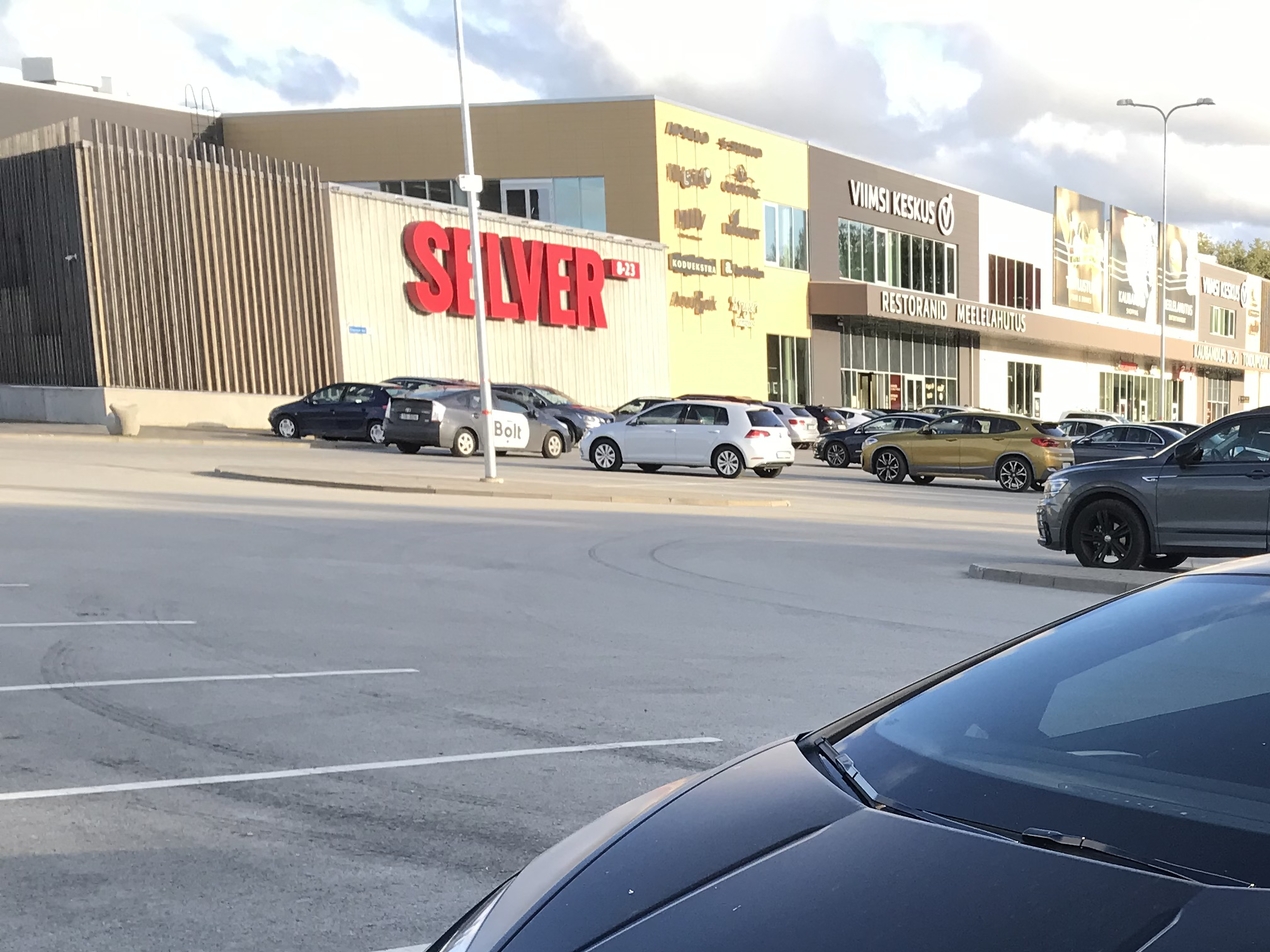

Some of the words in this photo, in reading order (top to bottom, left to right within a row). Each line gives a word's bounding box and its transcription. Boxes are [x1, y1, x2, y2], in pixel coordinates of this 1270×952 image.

[849, 179, 890, 214] VIIMSI
[892, 191, 935, 225] KESKUS
[402, 221, 608, 329] SELVER
[672, 259, 717, 274] KODUEKSTRA
[881, 291, 947, 321] RESTORANID
[956, 304, 1027, 333] MEELELAHUTUS
[494, 420, 522, 440] Bolt
